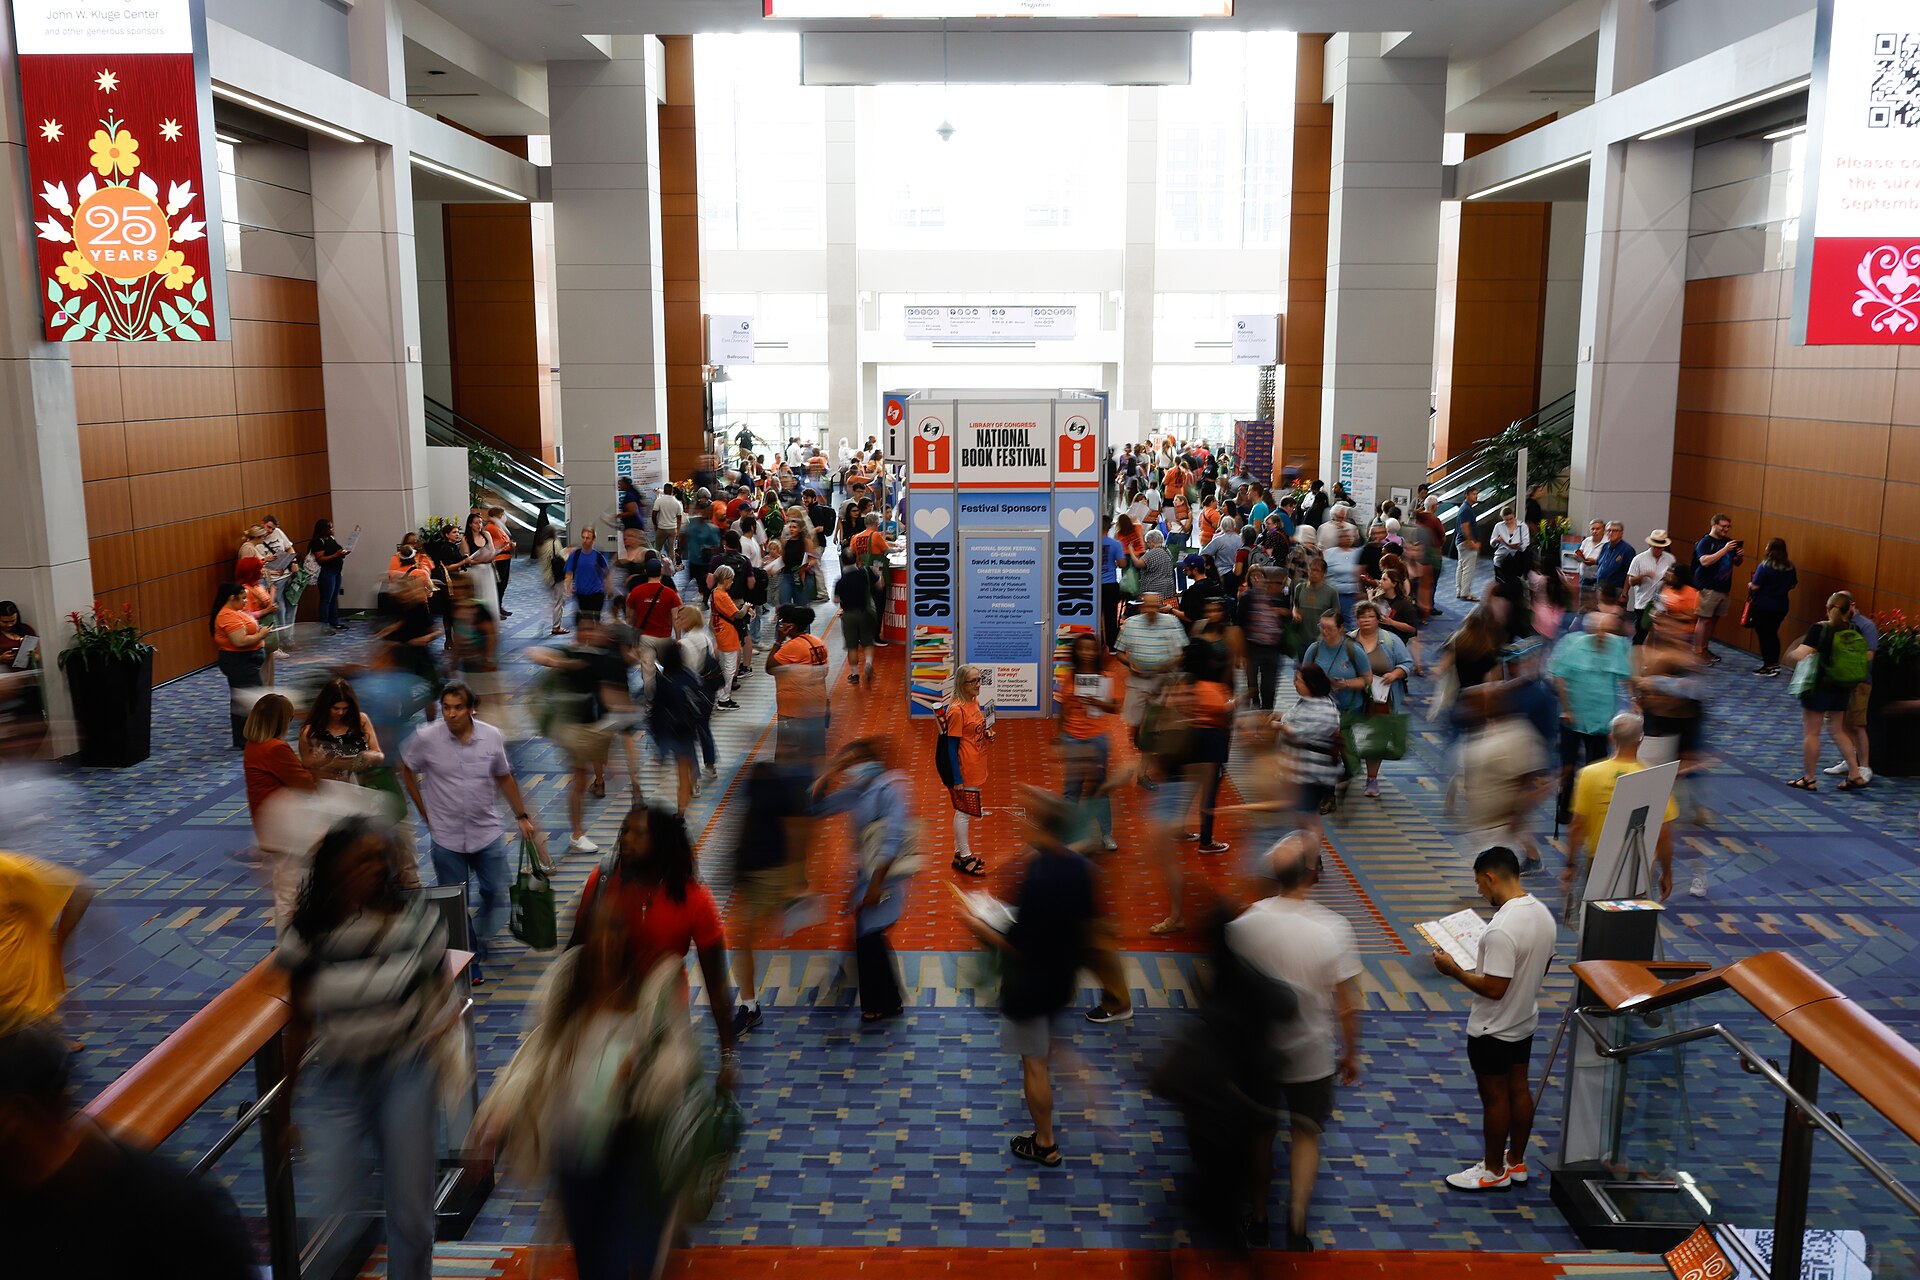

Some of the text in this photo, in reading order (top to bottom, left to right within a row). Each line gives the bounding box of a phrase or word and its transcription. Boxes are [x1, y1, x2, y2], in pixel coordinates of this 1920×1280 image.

[46, 10, 160, 21] John W. Kluge Center
[44, 27, 165, 37] and other generous sponsors
[1836, 157, 1894, 169] Please
[1849, 178, 1876, 189] the
[85, 205, 157, 245] 25
[89, 249, 158, 262] YEARS
[976, 428, 1030, 448] NATIONAL
[617, 453, 632, 477] EAST
[961, 447, 1047, 467] BOOK FESTIVAL
[1341, 453, 1353, 479] WEST
[961, 503, 1047, 514] Festival Sponsors
[914, 541, 950, 617] BOOKS
[1057, 541, 1095, 617] BOOKS
[1667, 1229, 1707, 1261] NATIONAL
[1672, 1239, 1713, 1271] FESTIVAL
